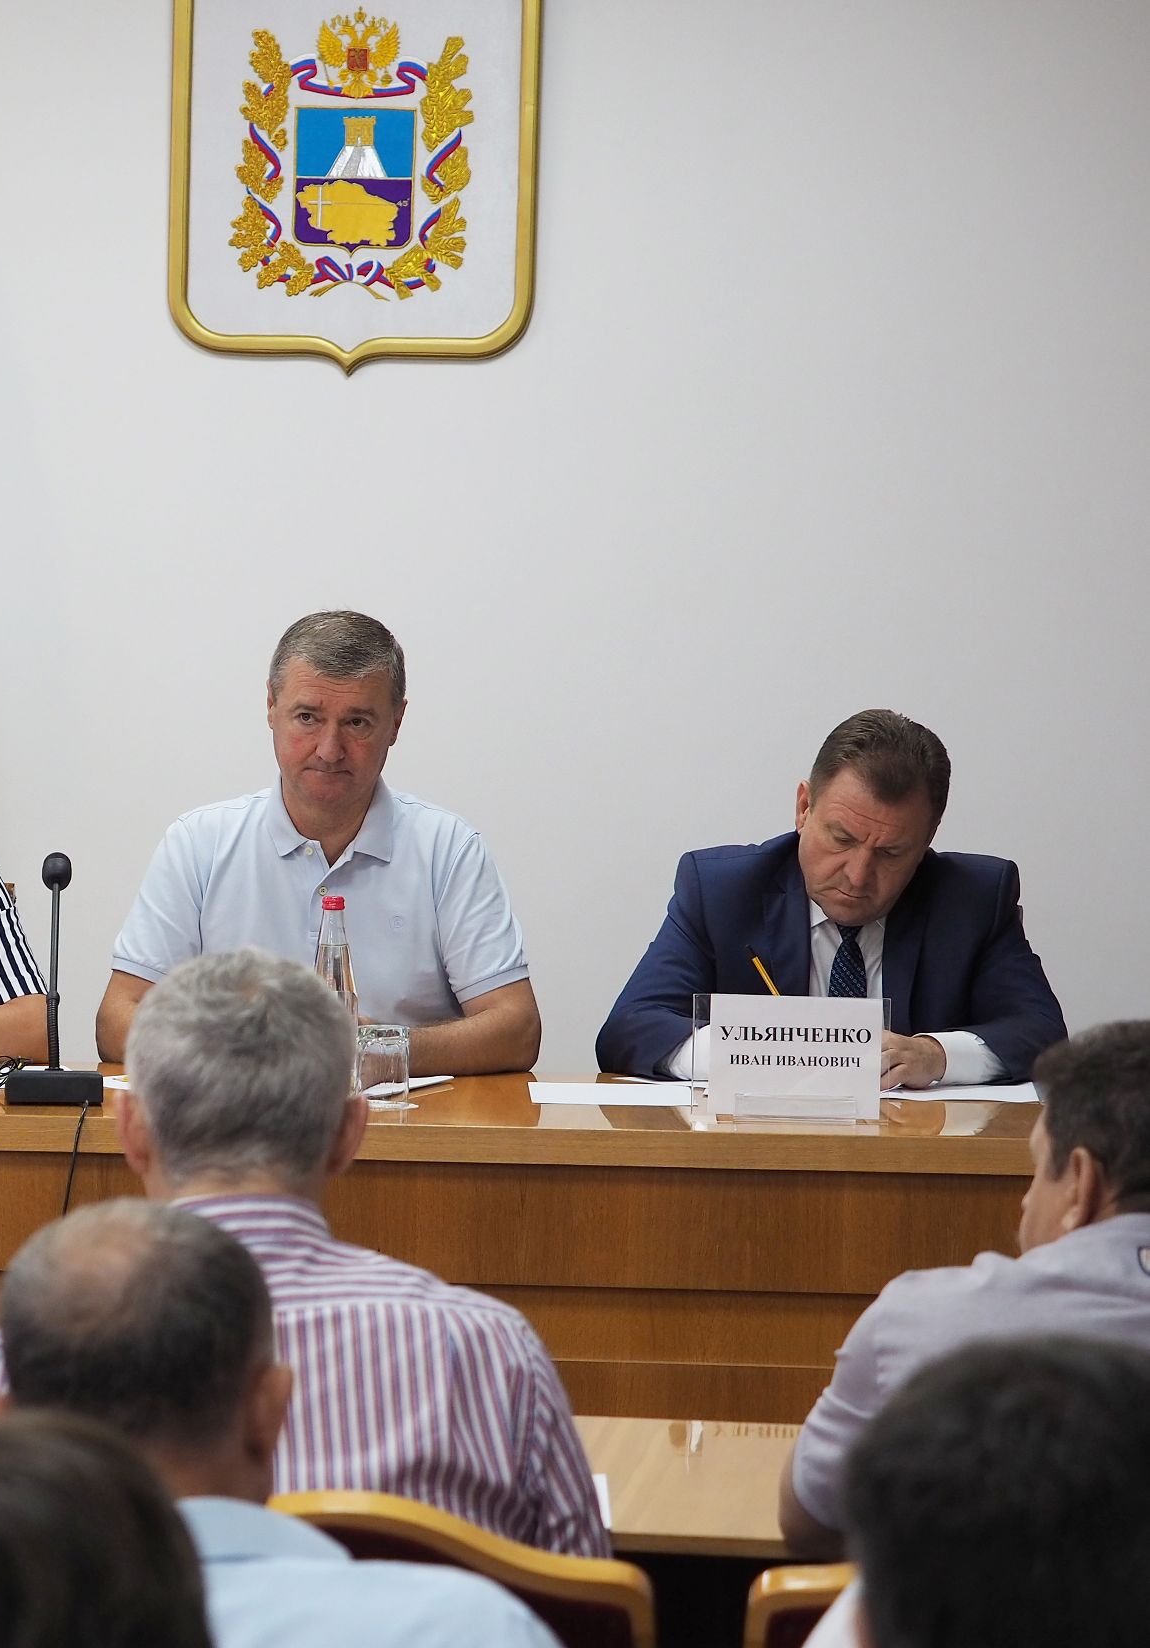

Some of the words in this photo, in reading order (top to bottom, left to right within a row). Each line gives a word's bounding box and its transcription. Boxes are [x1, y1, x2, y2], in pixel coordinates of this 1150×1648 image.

[719, 1025, 872, 1044] УЛЬЯНЧЕНКО
[729, 1054, 772, 1066] ИВАН
[775, 1055, 862, 1068] ИВАНОВИЧ
